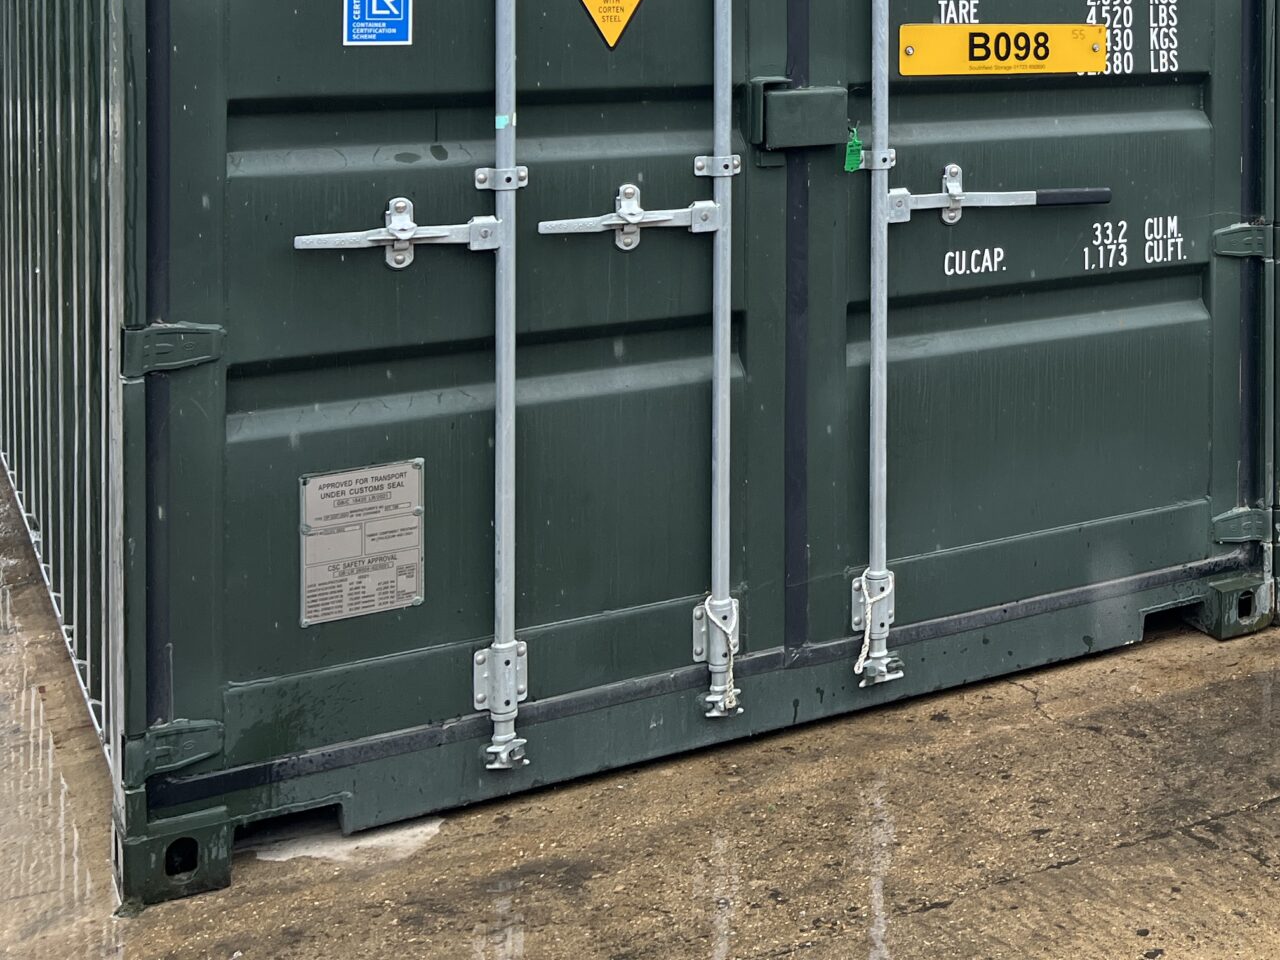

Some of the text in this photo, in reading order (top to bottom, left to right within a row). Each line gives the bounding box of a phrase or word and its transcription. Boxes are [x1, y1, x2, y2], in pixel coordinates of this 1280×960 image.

[598, 6, 625, 14] CORTEN
[602, 15, 621, 23] STEEL
[938, 0, 980, 24] TARE
[1149, 5, 1178, 28] LBS
[968, 31, 1050, 62] B098
[1149, 27, 1178, 50] KGS
[1150, 50, 1179, 73] LBS
[1092, 216, 1182, 246] 33.2 CU.M.
[944, 247, 1007, 275] CU.CAP.
[1144, 237, 1187, 263] CU.FT.
[318, 471, 407, 491] APPROVED FOR TRANSPORT
[320, 481, 405, 500] UNDER CUSTOMS SEAL
[327, 564, 341, 572] CSC
[343, 559, 365, 569] SAFETY
[367, 554, 397, 565] APPROVAL
